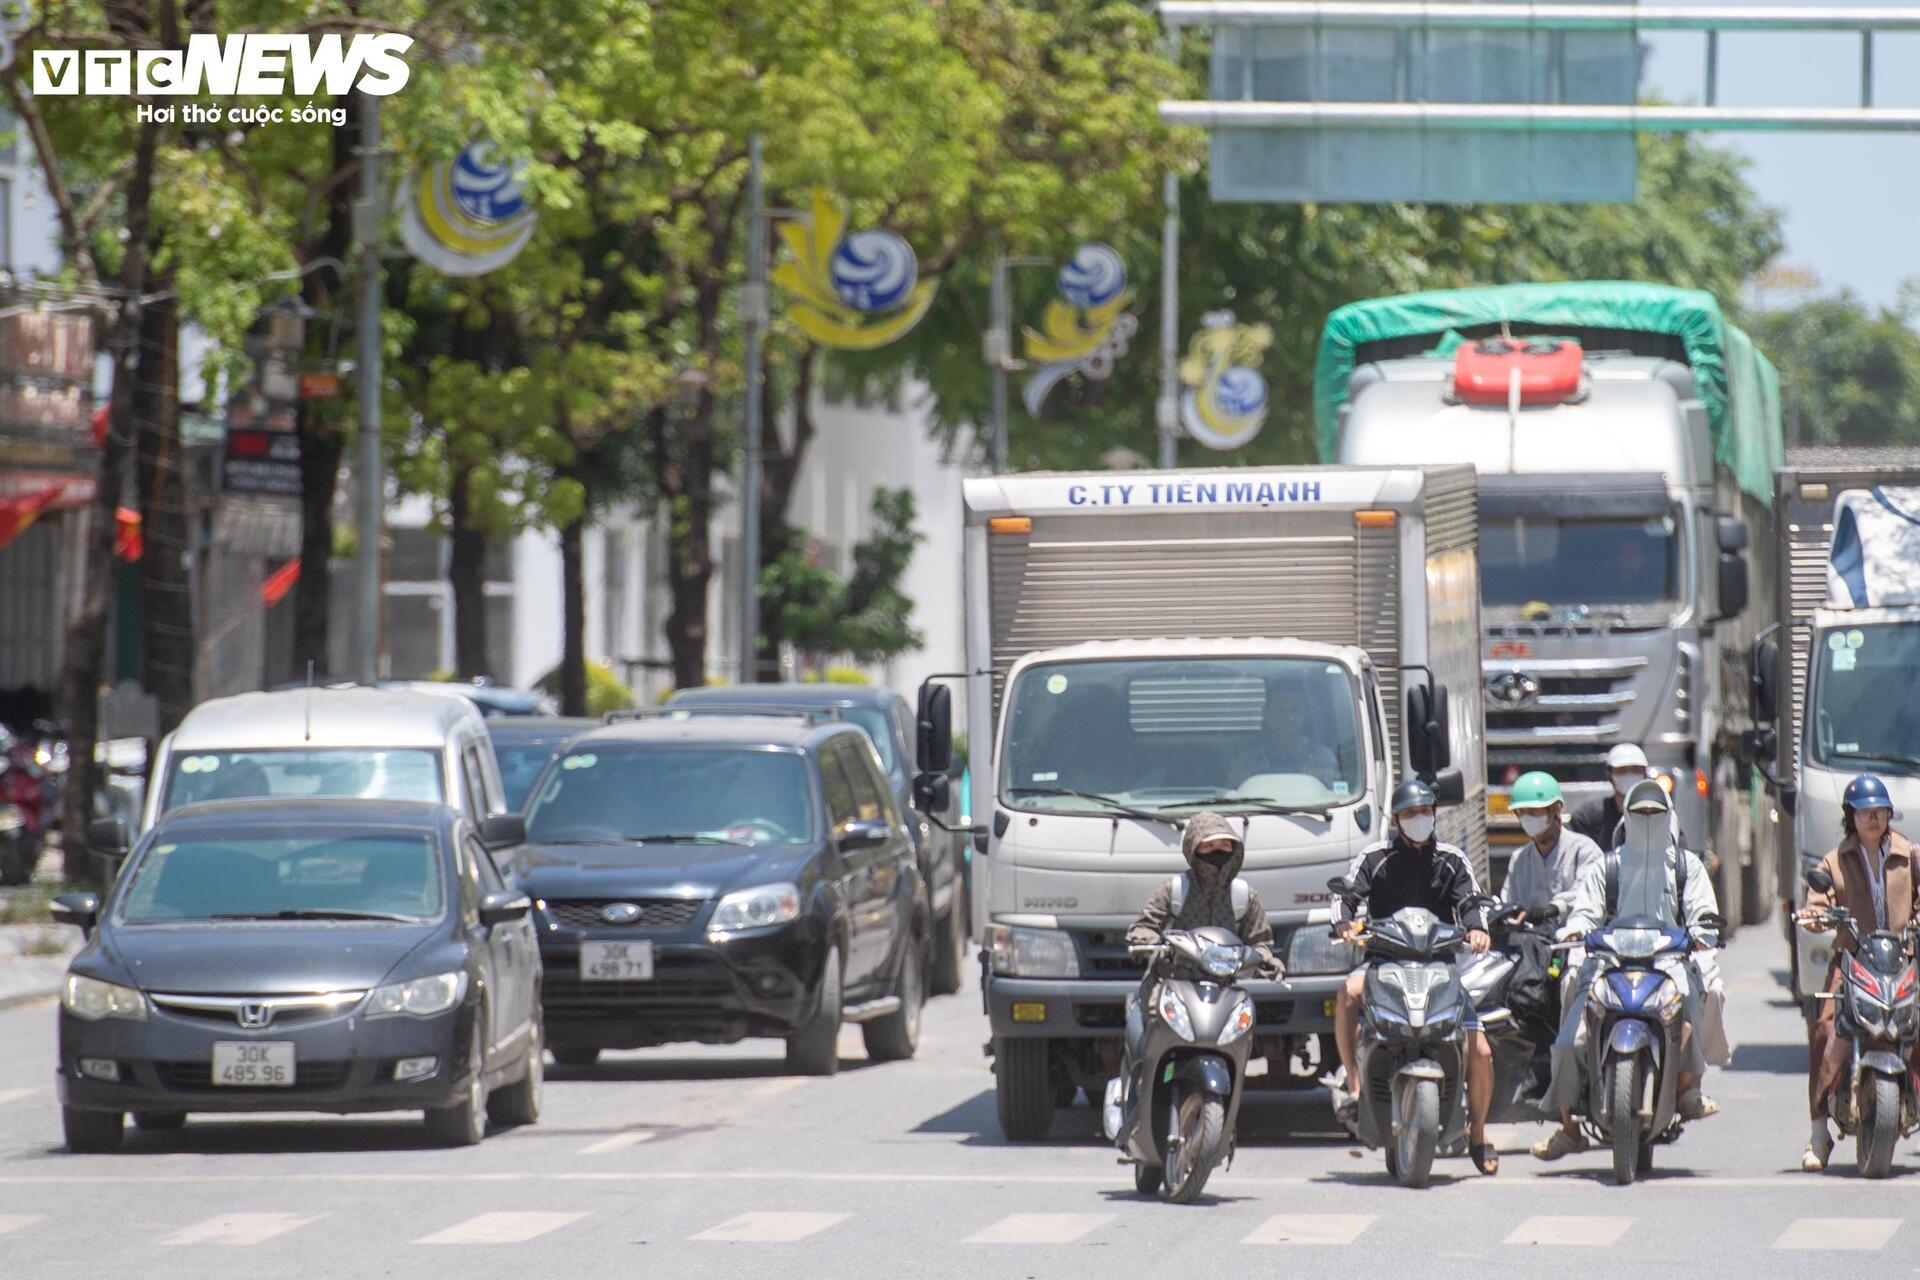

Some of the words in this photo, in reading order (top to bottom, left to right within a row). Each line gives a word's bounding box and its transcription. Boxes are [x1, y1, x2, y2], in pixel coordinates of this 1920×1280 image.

[1068, 484, 1135, 506] C.TY
[1225, 481, 1322, 508] MẠNH
[236, 1045, 271, 1063] 30K
